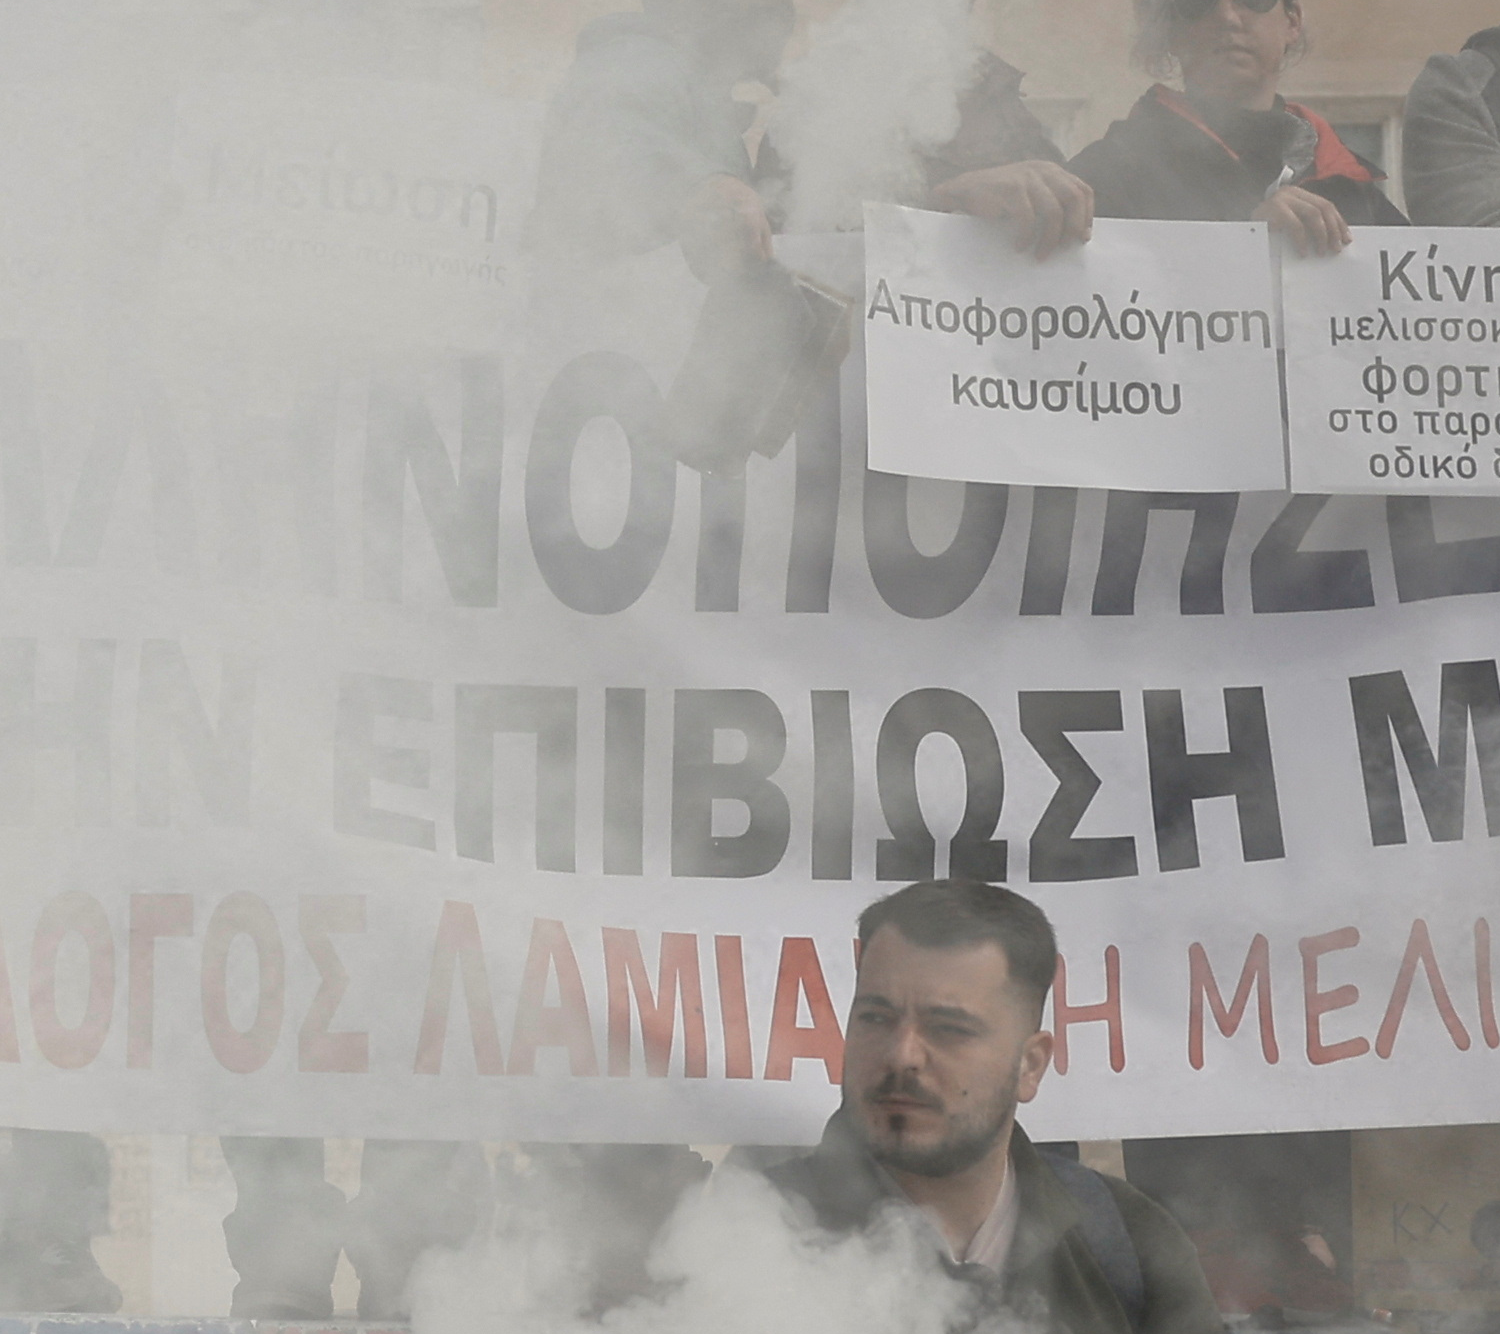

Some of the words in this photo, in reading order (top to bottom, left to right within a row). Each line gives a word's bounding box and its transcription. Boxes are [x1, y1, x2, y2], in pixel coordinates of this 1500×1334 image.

[864, 277, 1273, 357] Αποφορολόγηση
[949, 356, 1184, 422] καυσίμου
[1327, 404, 1399, 436] στο
[1366, 444, 1478, 482] οδικό
[332, 679, 1287, 885] ΕΠΙΒΙΩΣΗ
[412, 899, 862, 1085] ΛΑΜΙΑ
